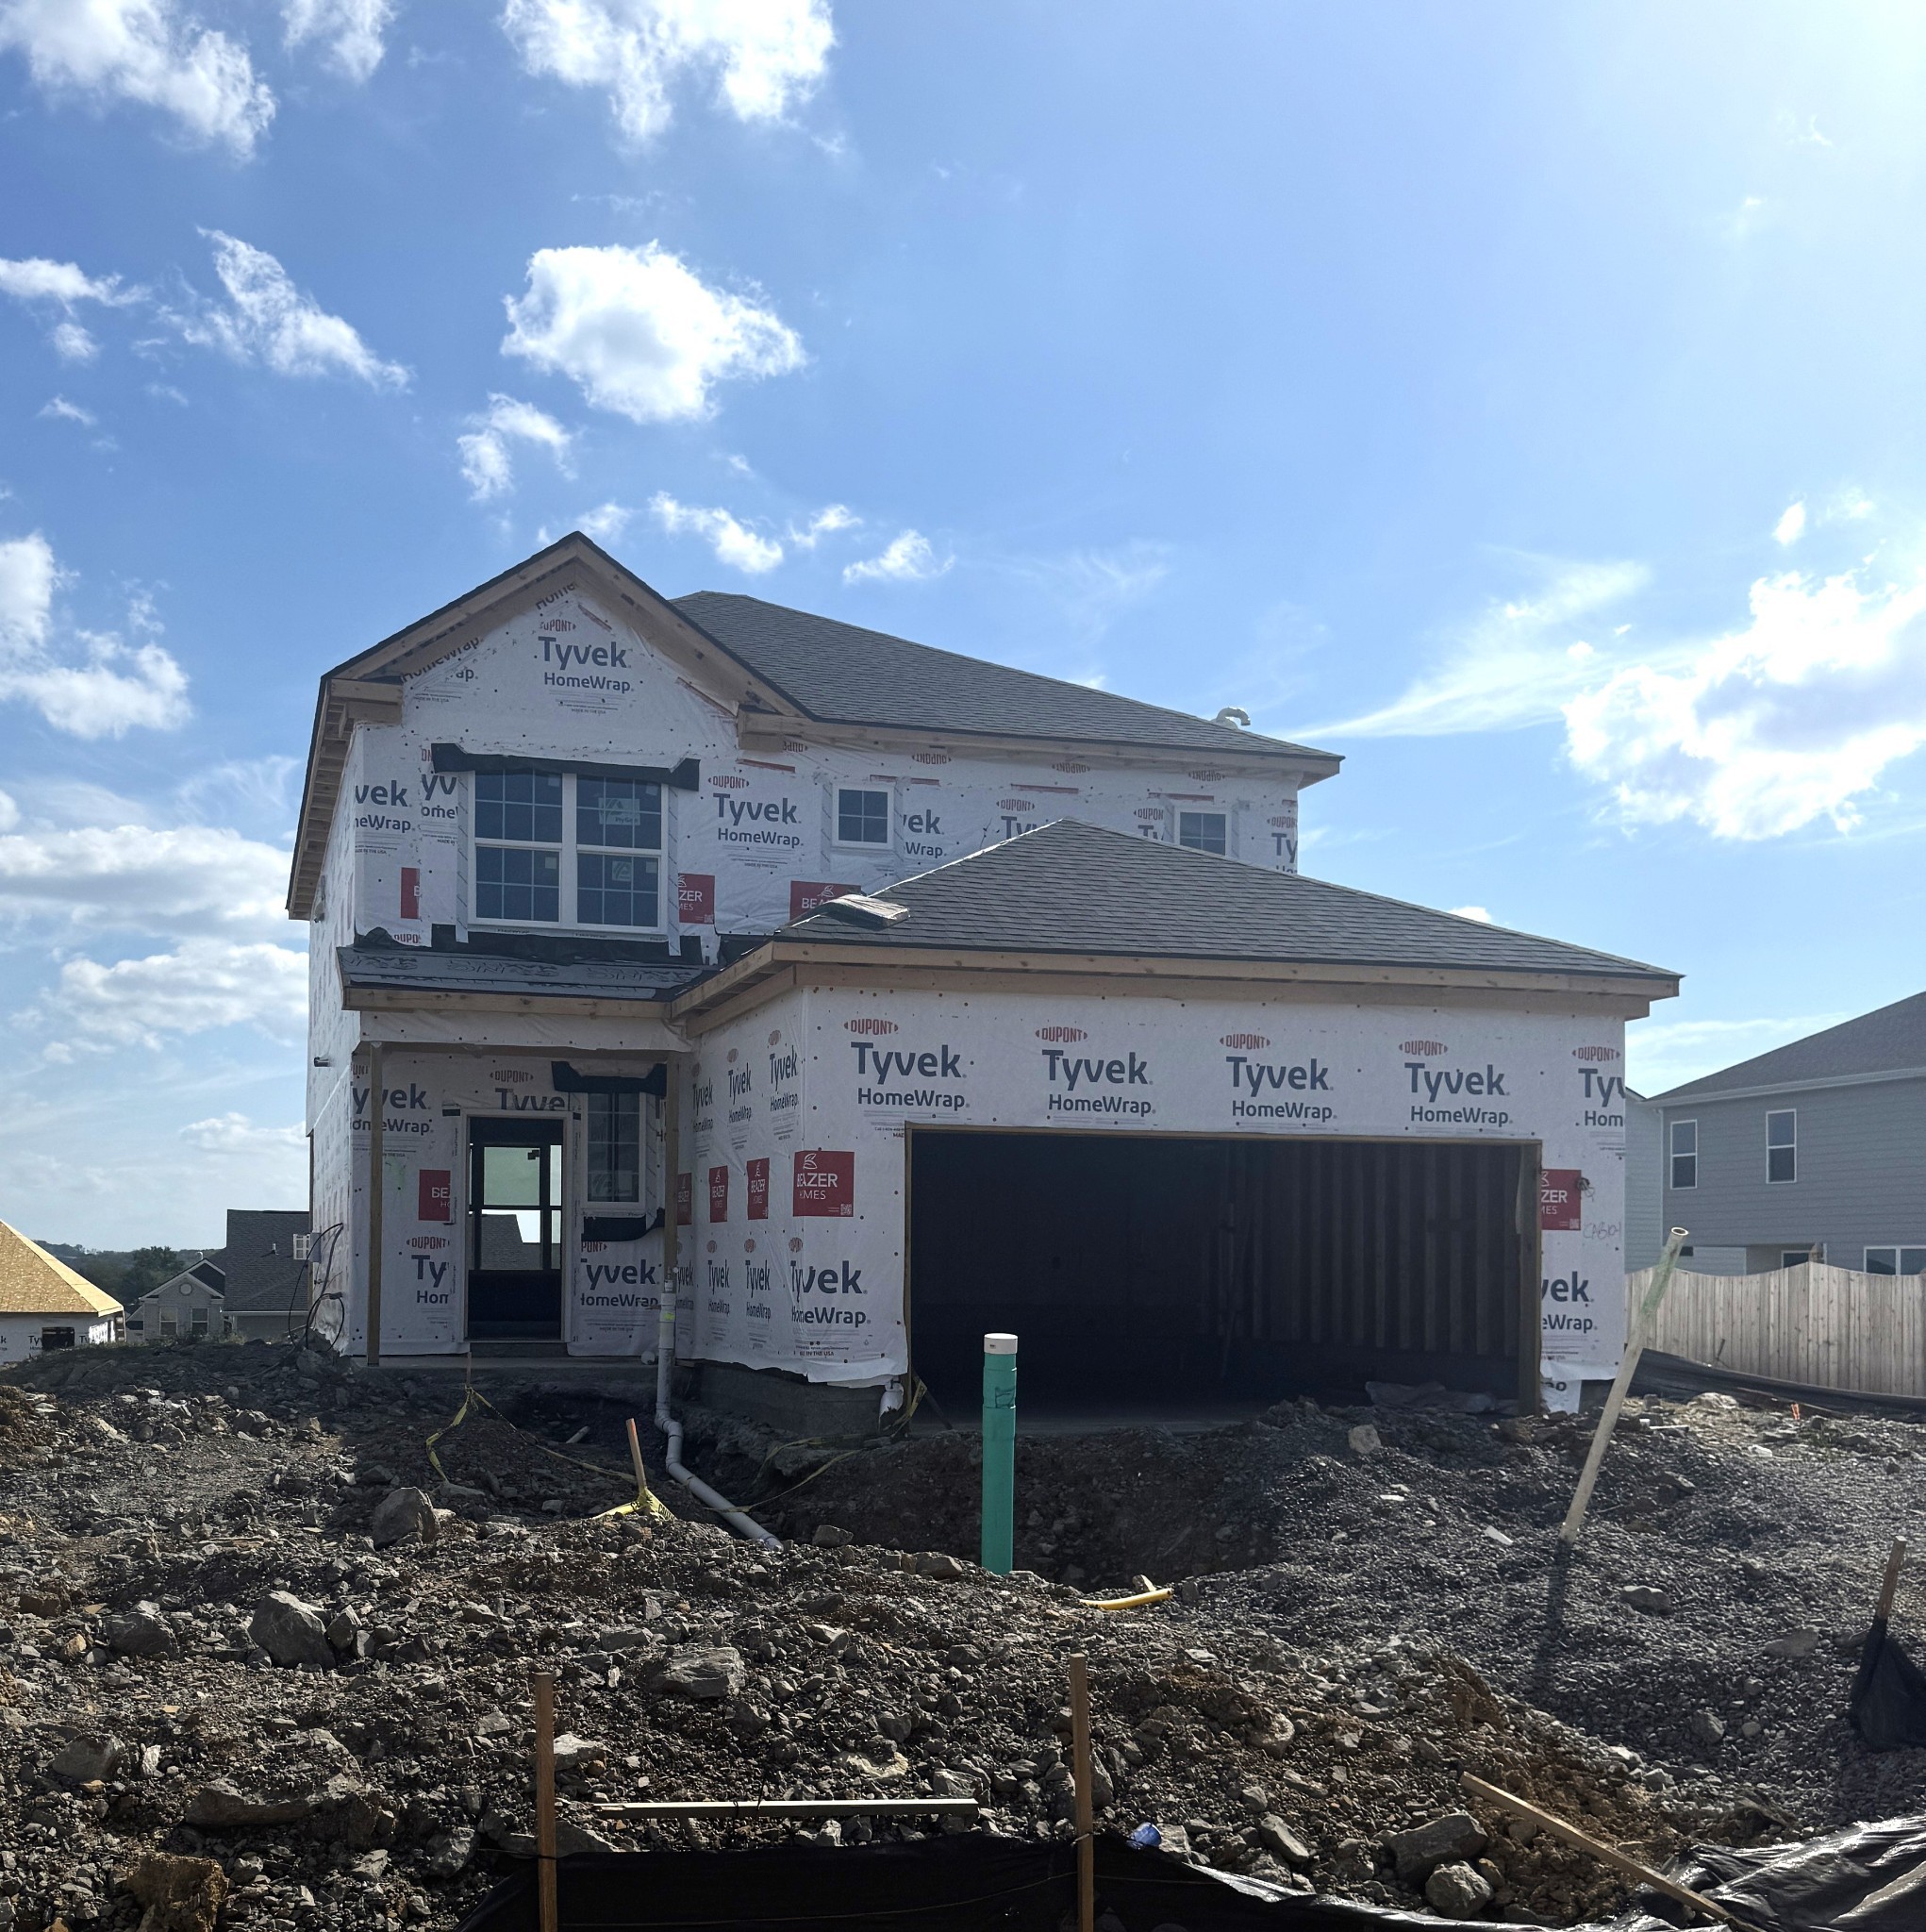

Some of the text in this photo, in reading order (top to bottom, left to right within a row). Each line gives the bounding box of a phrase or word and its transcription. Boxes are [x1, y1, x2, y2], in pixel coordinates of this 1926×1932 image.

[538, 636, 628, 671] Tyvek
[544, 672, 631, 694] HomeWrap
[712, 775, 746, 790] DUPONT
[713, 793, 798, 826] Tyvek
[718, 828, 801, 849] HomeWrap
[850, 1019, 894, 1036] DUPONT
[1041, 1026, 1083, 1042] DUPONT
[1225, 1033, 1266, 1050] DUPONT
[1403, 1041, 1444, 1056] DUPONT
[850, 1041, 962, 1085] Tyvek
[1577, 1046, 1616, 1062] DUPONT
[495, 1070, 529, 1084] DUPONT
[769, 1044, 798, 1092] Tyvek
[1041, 1049, 1149, 1091] Tyvek
[1225, 1056, 1330, 1097] Tyvek
[728, 1062, 752, 1106] Tyvek
[1403, 1062, 1505, 1103] Tyvek
[770, 1091, 799, 1112] HomeWrap
[857, 1088, 966, 1111] HomeWrap
[1048, 1094, 1152, 1118] HomeWrap
[1232, 1100, 1333, 1124] HomeWrap
[1410, 1106, 1509, 1127] HomeWrap
[1541, 1190, 1568, 1204] ZER
[411, 1236, 446, 1250] DUPONT
[707, 1259, 730, 1295] Tyvek
[745, 1259, 771, 1299] Tyvek
[789, 1260, 863, 1303] Tyvek
